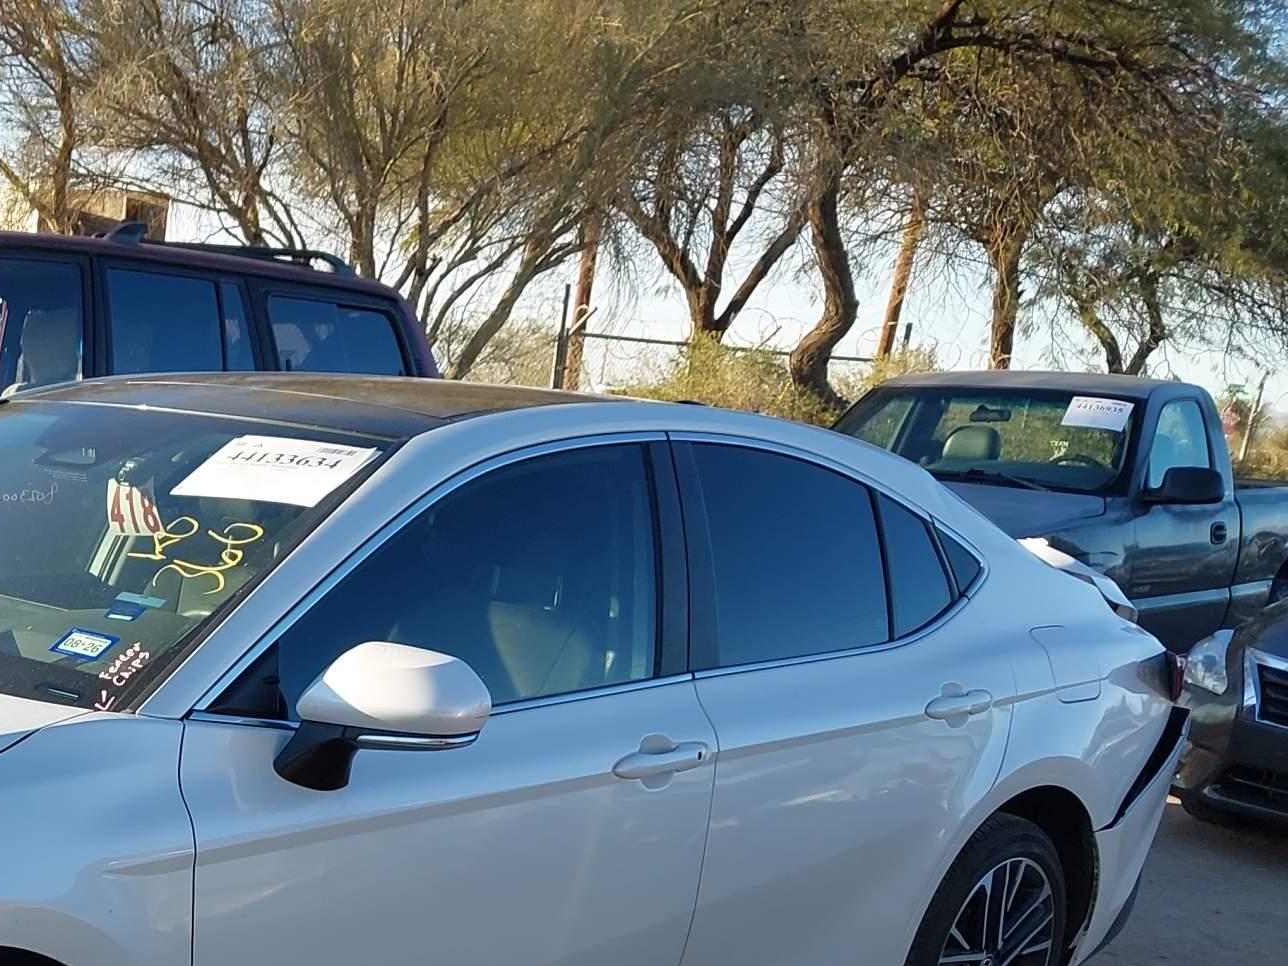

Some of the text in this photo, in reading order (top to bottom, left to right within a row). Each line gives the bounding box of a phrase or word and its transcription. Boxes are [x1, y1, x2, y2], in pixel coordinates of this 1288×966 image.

[227, 450, 343, 469] 44133634
[109, 485, 162, 534] 418
[152, 522, 265, 596] 360
[63, 637, 102, 654] 08 26
